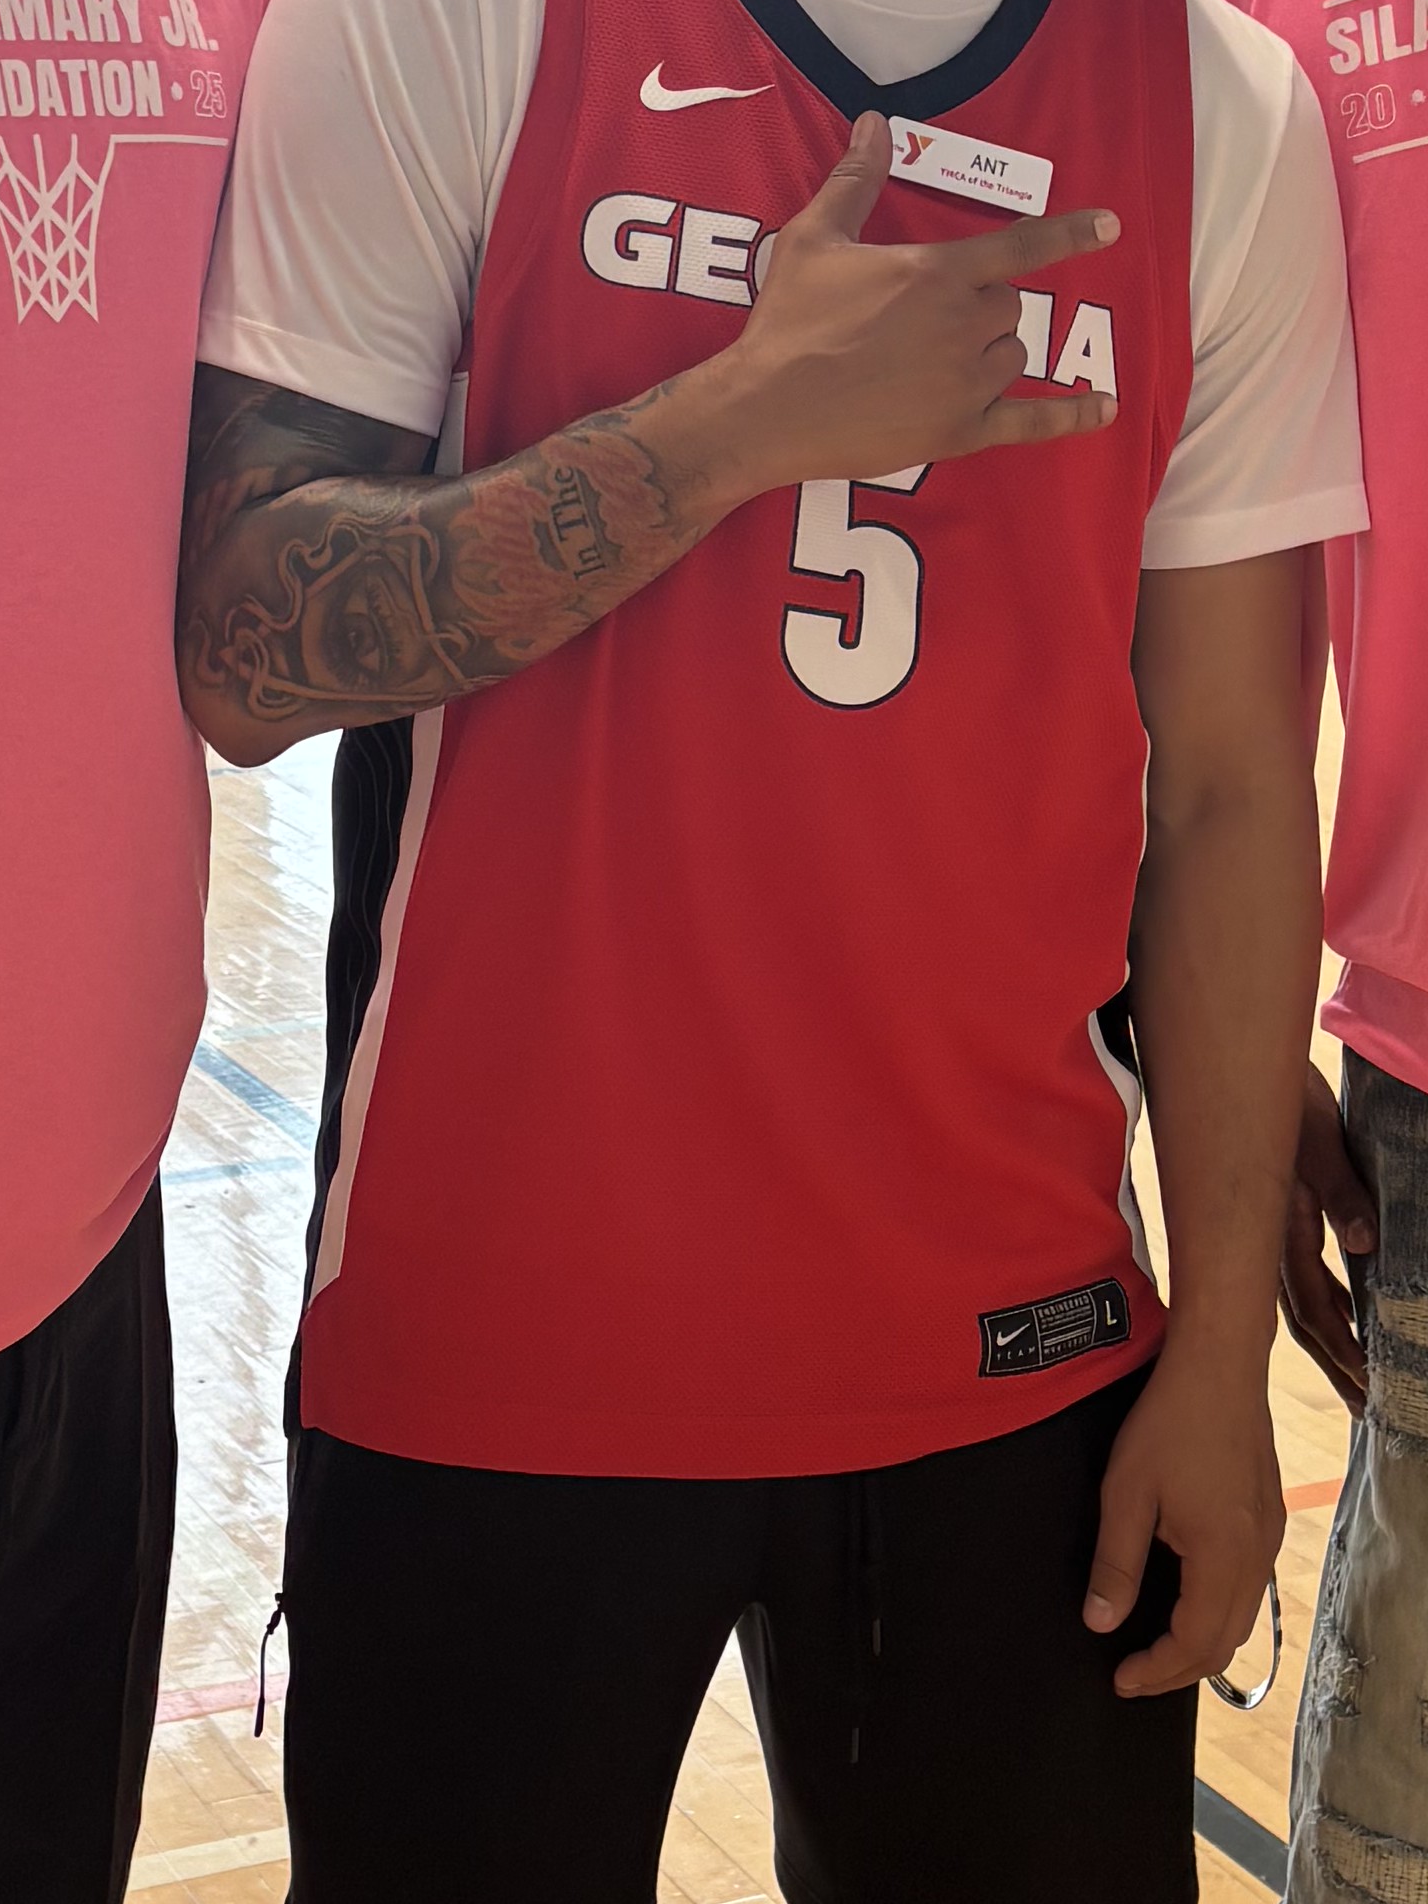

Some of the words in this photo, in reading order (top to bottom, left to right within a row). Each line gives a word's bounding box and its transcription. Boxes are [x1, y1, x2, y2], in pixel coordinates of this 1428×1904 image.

[189, 69, 228, 119] 25
[1340, 83, 1397, 139] 20
[940, 167, 967, 182] YMCA
[968, 175, 978, 185] of
[980, 178, 994, 190] the
[996, 183, 1033, 202] Triangle
[970, 153, 1009, 178] ANT
[581, 190, 1119, 403] GEIA
[781, 462, 933, 711] 5
[1105, 1300, 1117, 1325] L
